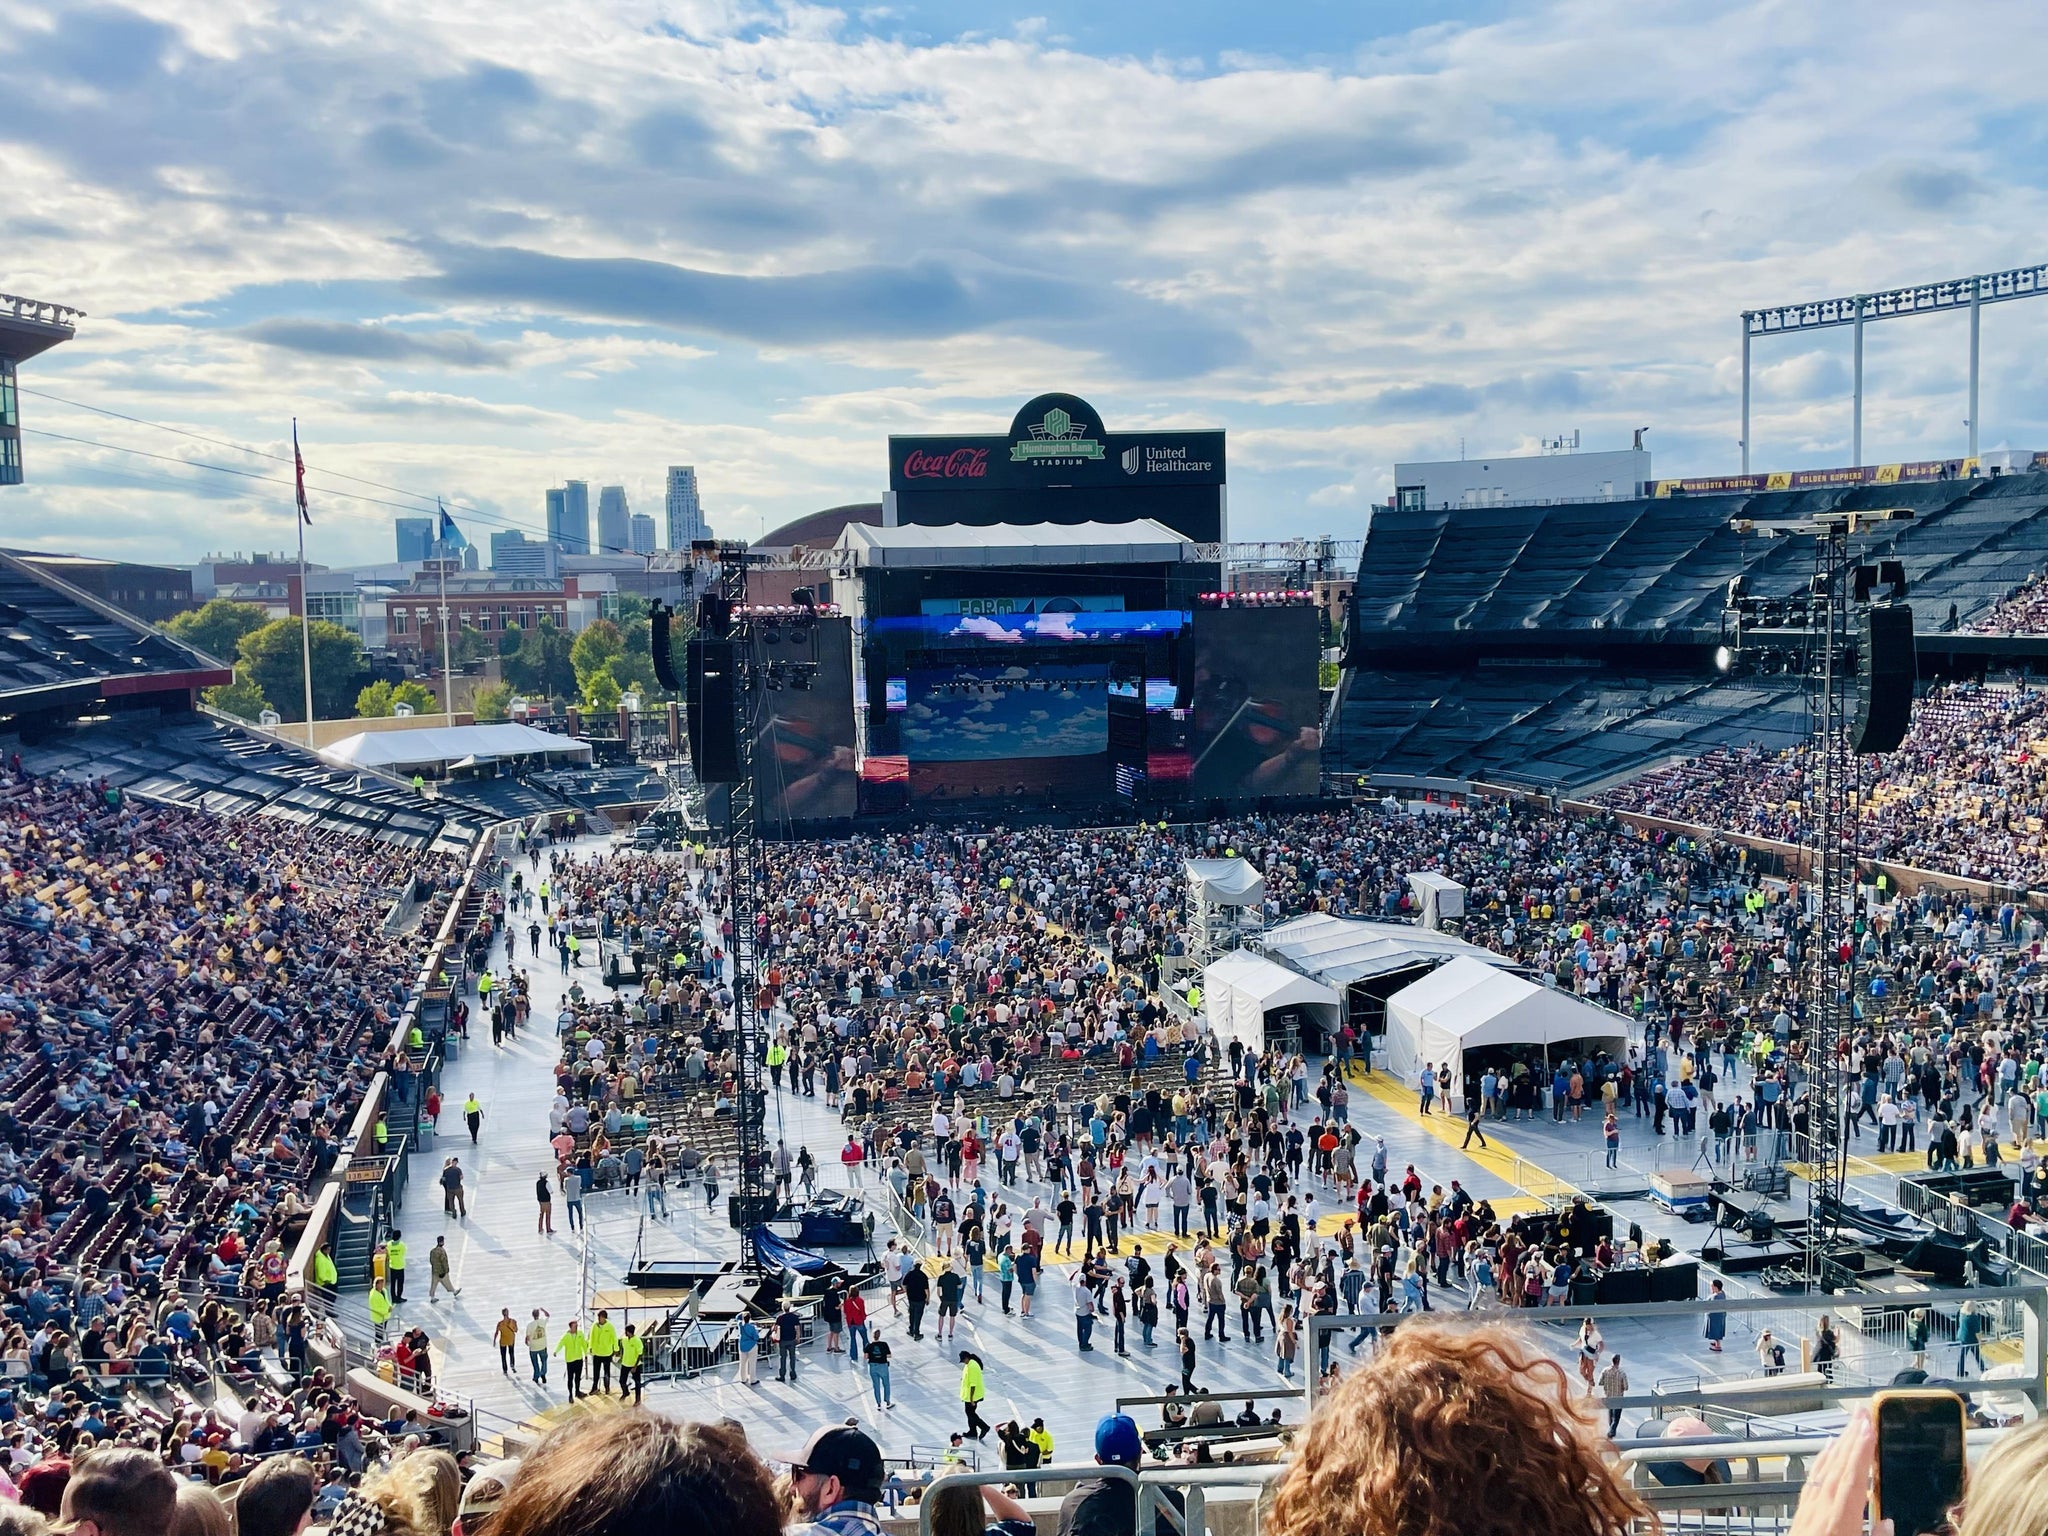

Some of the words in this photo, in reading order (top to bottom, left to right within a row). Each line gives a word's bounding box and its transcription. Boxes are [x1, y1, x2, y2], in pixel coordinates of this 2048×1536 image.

[1022, 444, 1070, 455] Huntington
[1071, 443, 1093, 452] Bank
[1146, 447, 1187, 459] United
[903, 448, 990, 479] Coca-Cola
[1146, 460, 1212, 472] Healthcare
[1800, 474, 1827, 483] GOLDEN
[1830, 472, 1862, 481] GOPHERS
[1725, 480, 1758, 488] FOOTBALL
